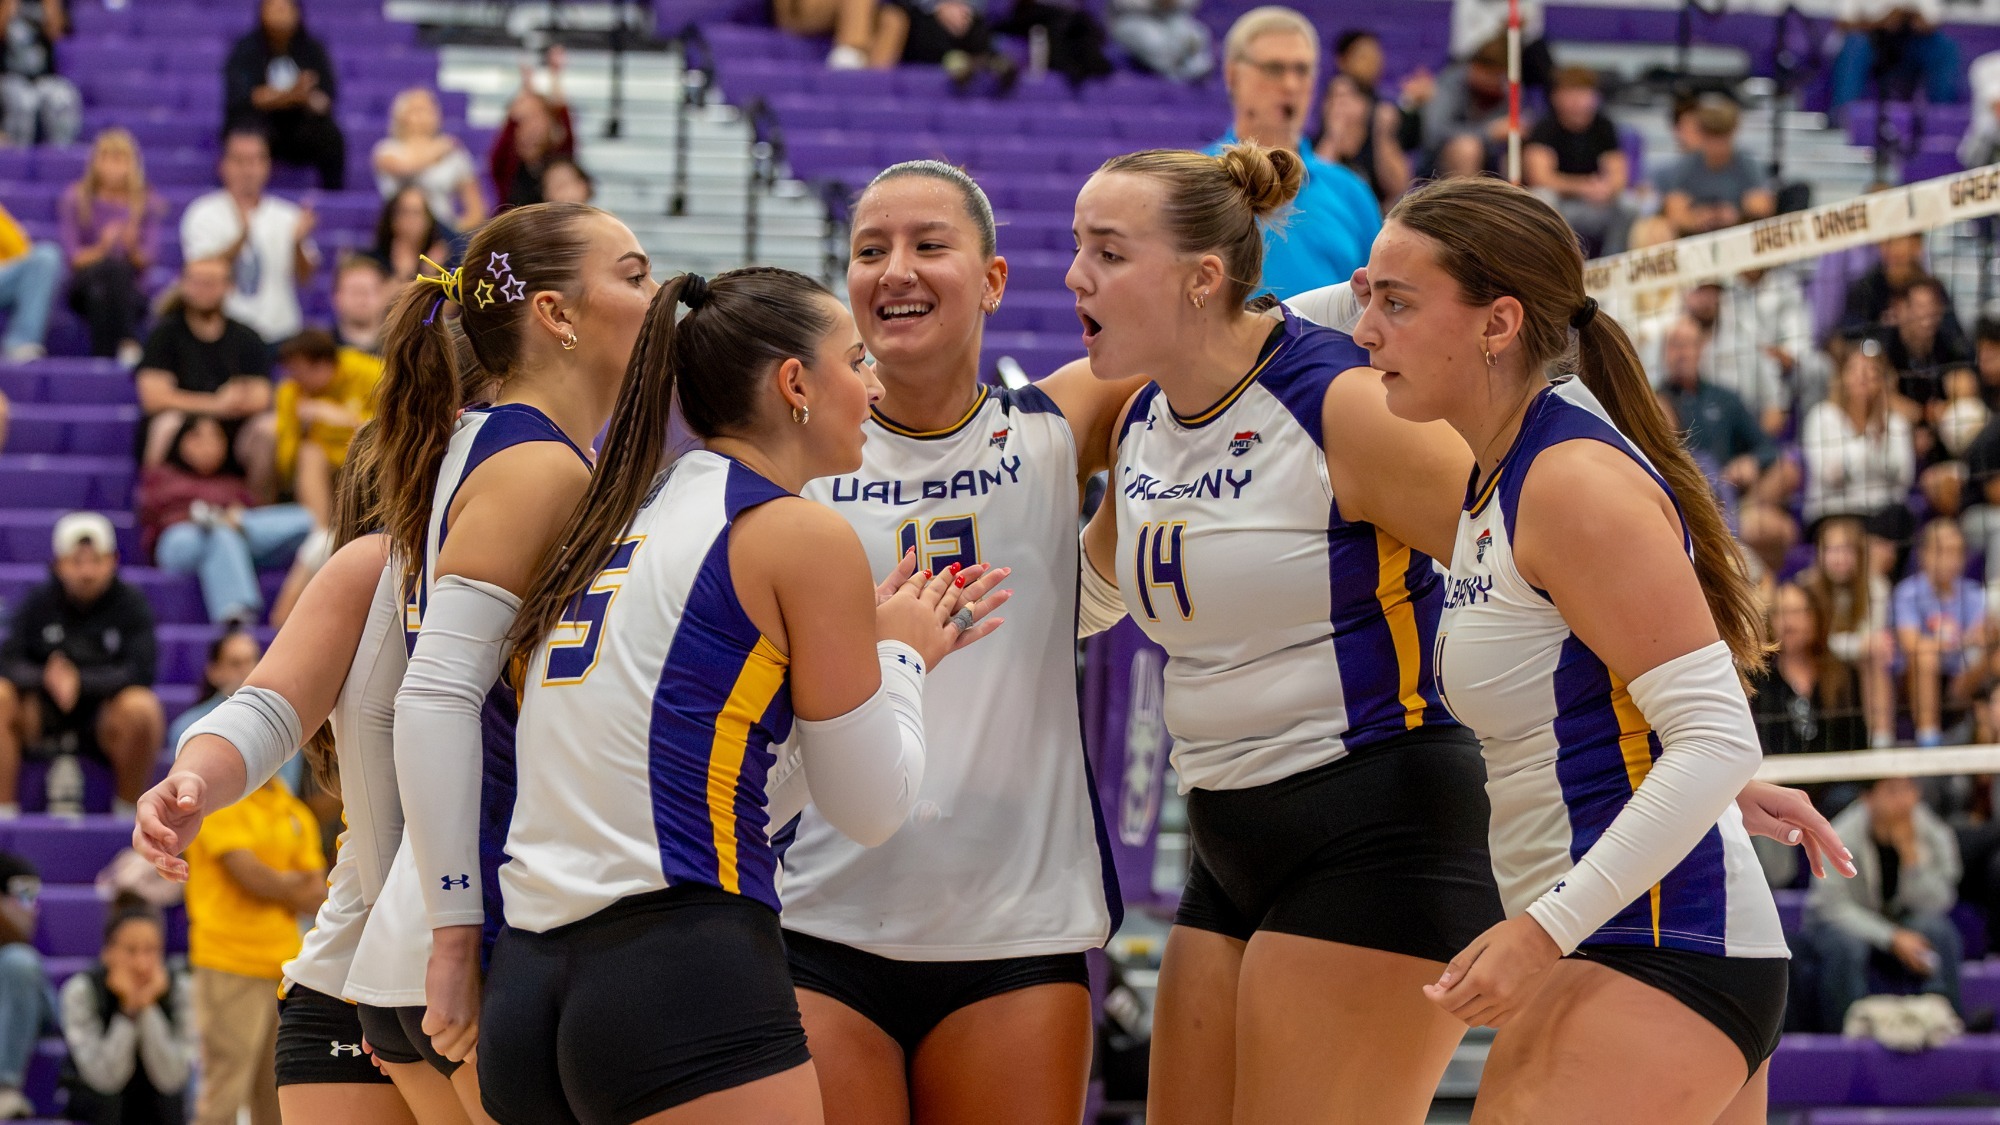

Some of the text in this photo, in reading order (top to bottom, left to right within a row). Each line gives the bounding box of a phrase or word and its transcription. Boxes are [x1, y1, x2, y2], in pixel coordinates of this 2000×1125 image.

[1950, 171, 2000, 206] GREA
[833, 455, 1021, 505] UALBANY
[1134, 521, 1195, 622] 14
[541, 534, 648, 688] 5
